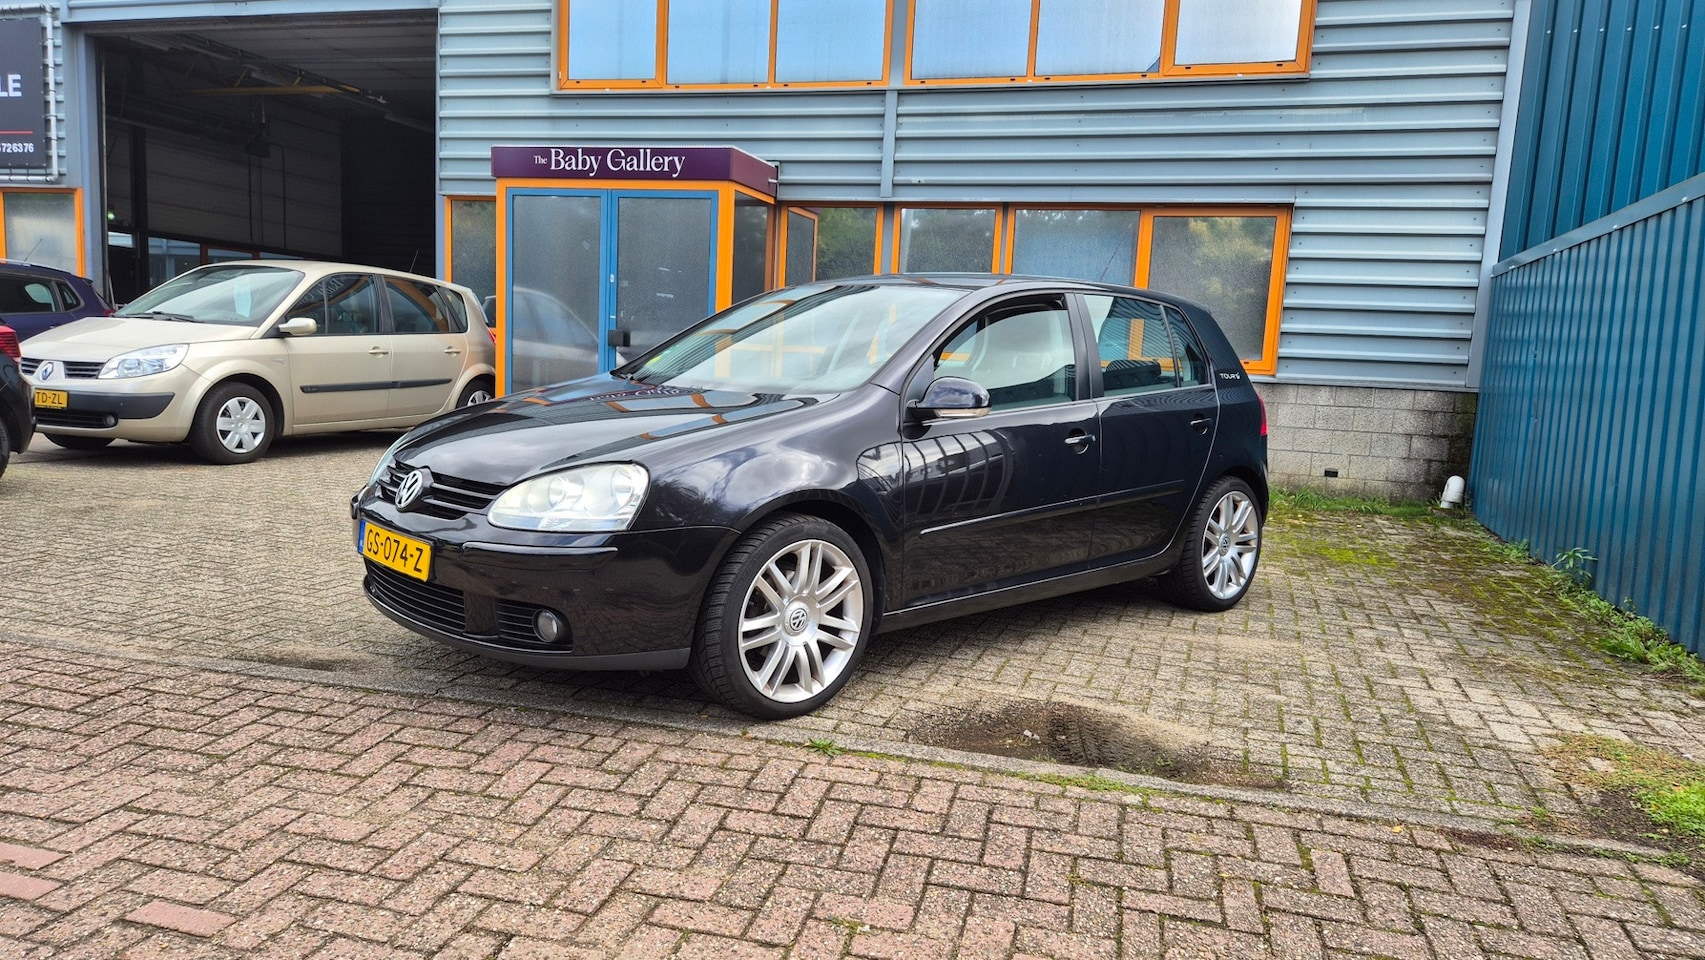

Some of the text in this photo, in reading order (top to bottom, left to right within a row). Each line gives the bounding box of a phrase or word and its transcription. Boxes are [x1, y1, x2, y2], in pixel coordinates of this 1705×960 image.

[0, 142, 34, 153] 726376
[533, 148, 686, 178] The Baby Gallery
[35, 391, 63, 405] TD-ZL
[366, 529, 424, 573] GS-074-Z
